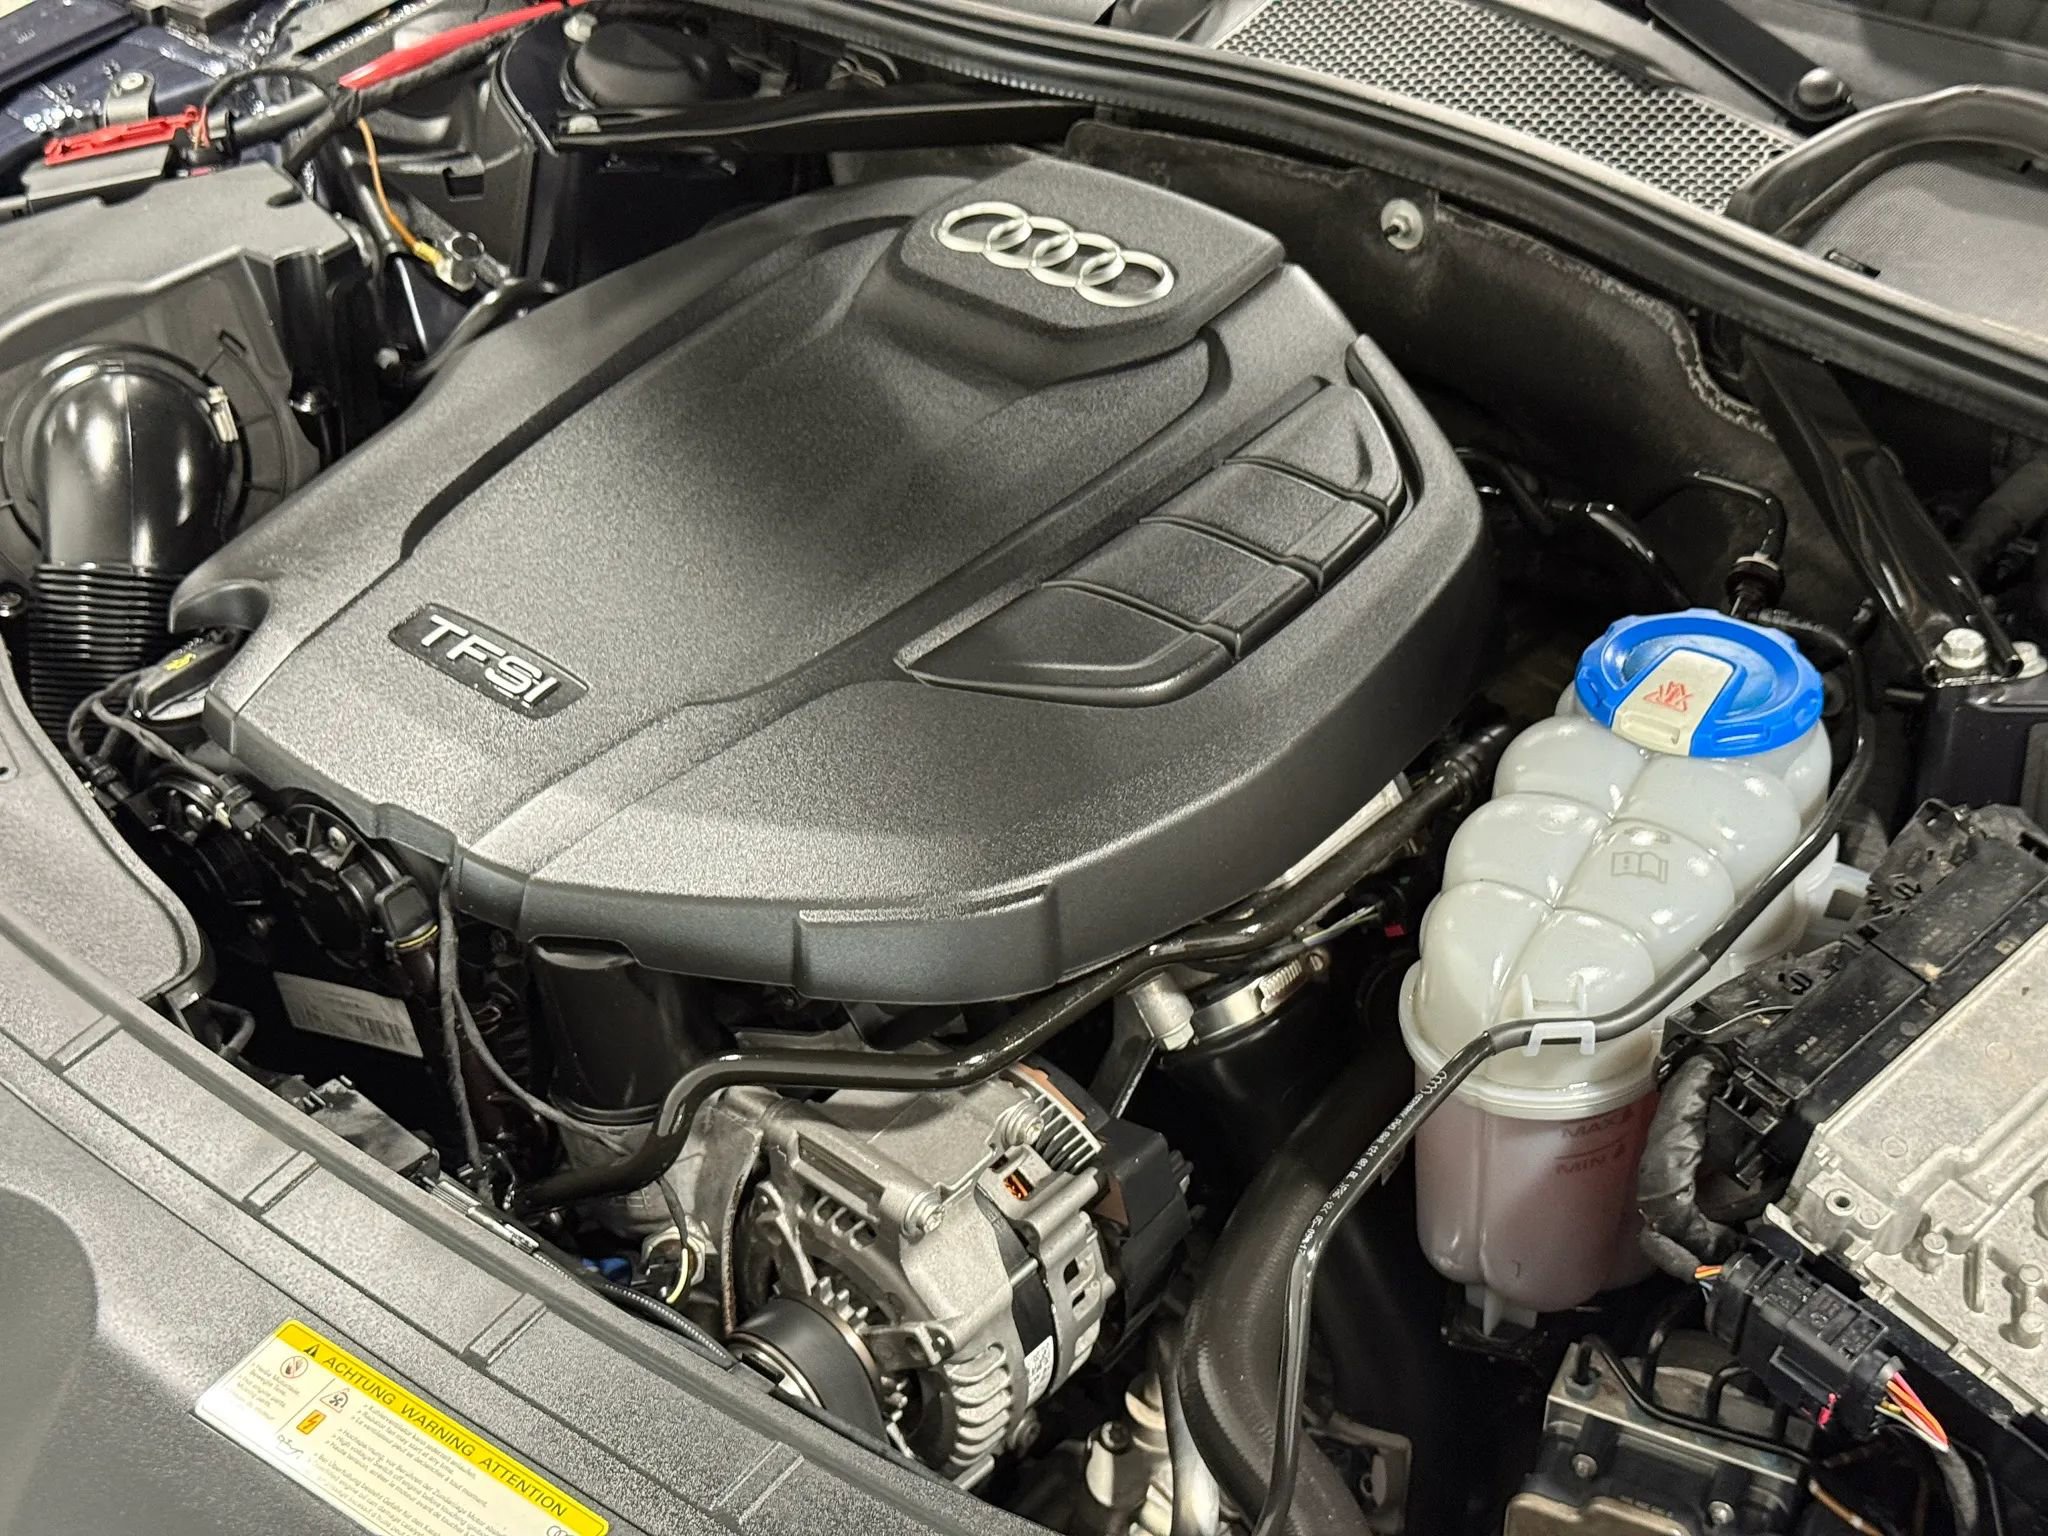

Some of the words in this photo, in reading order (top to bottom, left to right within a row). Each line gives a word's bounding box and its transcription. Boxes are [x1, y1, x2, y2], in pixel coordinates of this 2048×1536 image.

[421, 614, 560, 705] TFSI
[1561, 1118, 1614, 1138] MAX
[1555, 1154, 1606, 1176] MIN
[323, 1356, 396, 1406] ACHTUNG
[400, 1403, 475, 1457] WARNING
[478, 1456, 568, 1517] ATTENTION
